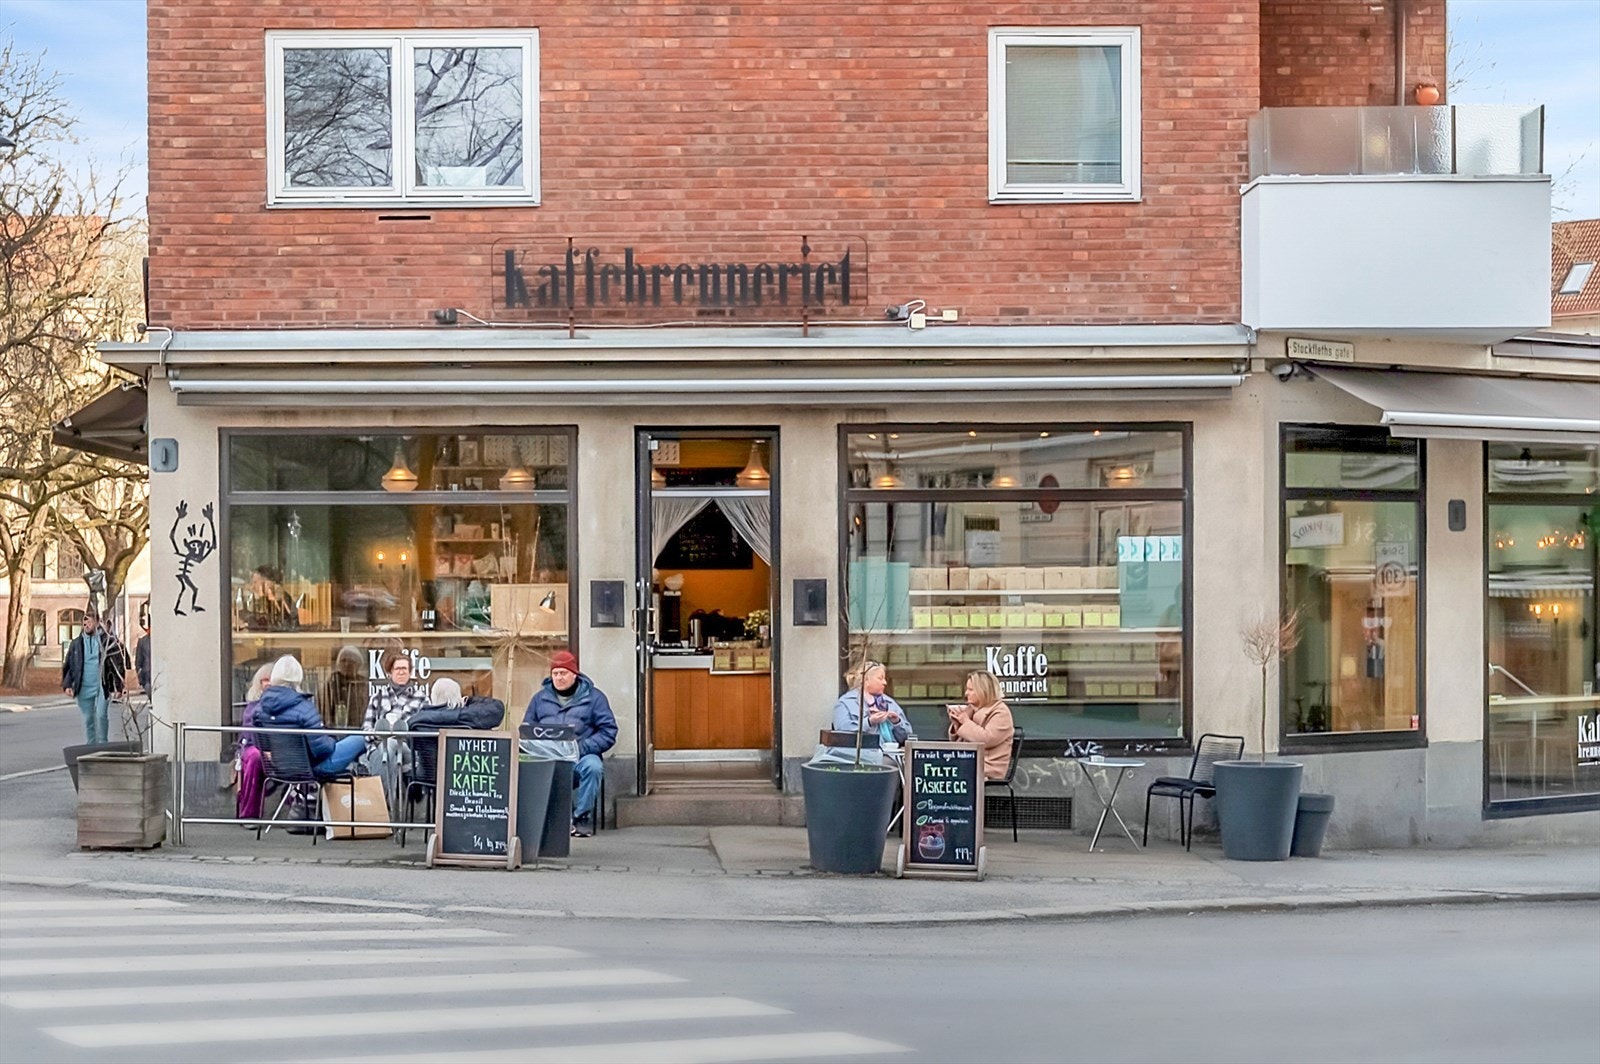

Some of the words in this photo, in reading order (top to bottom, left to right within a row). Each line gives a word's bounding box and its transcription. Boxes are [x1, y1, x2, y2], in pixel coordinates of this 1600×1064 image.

[1292, 341, 1333, 357] Stockfleths
[1335, 346, 1350, 360] gate
[985, 645, 1048, 677] Kaffe
[999, 677, 1048, 693] enneriet
[923, 763, 959, 777] FYLTE
[453, 773, 497, 793] KAFFE
